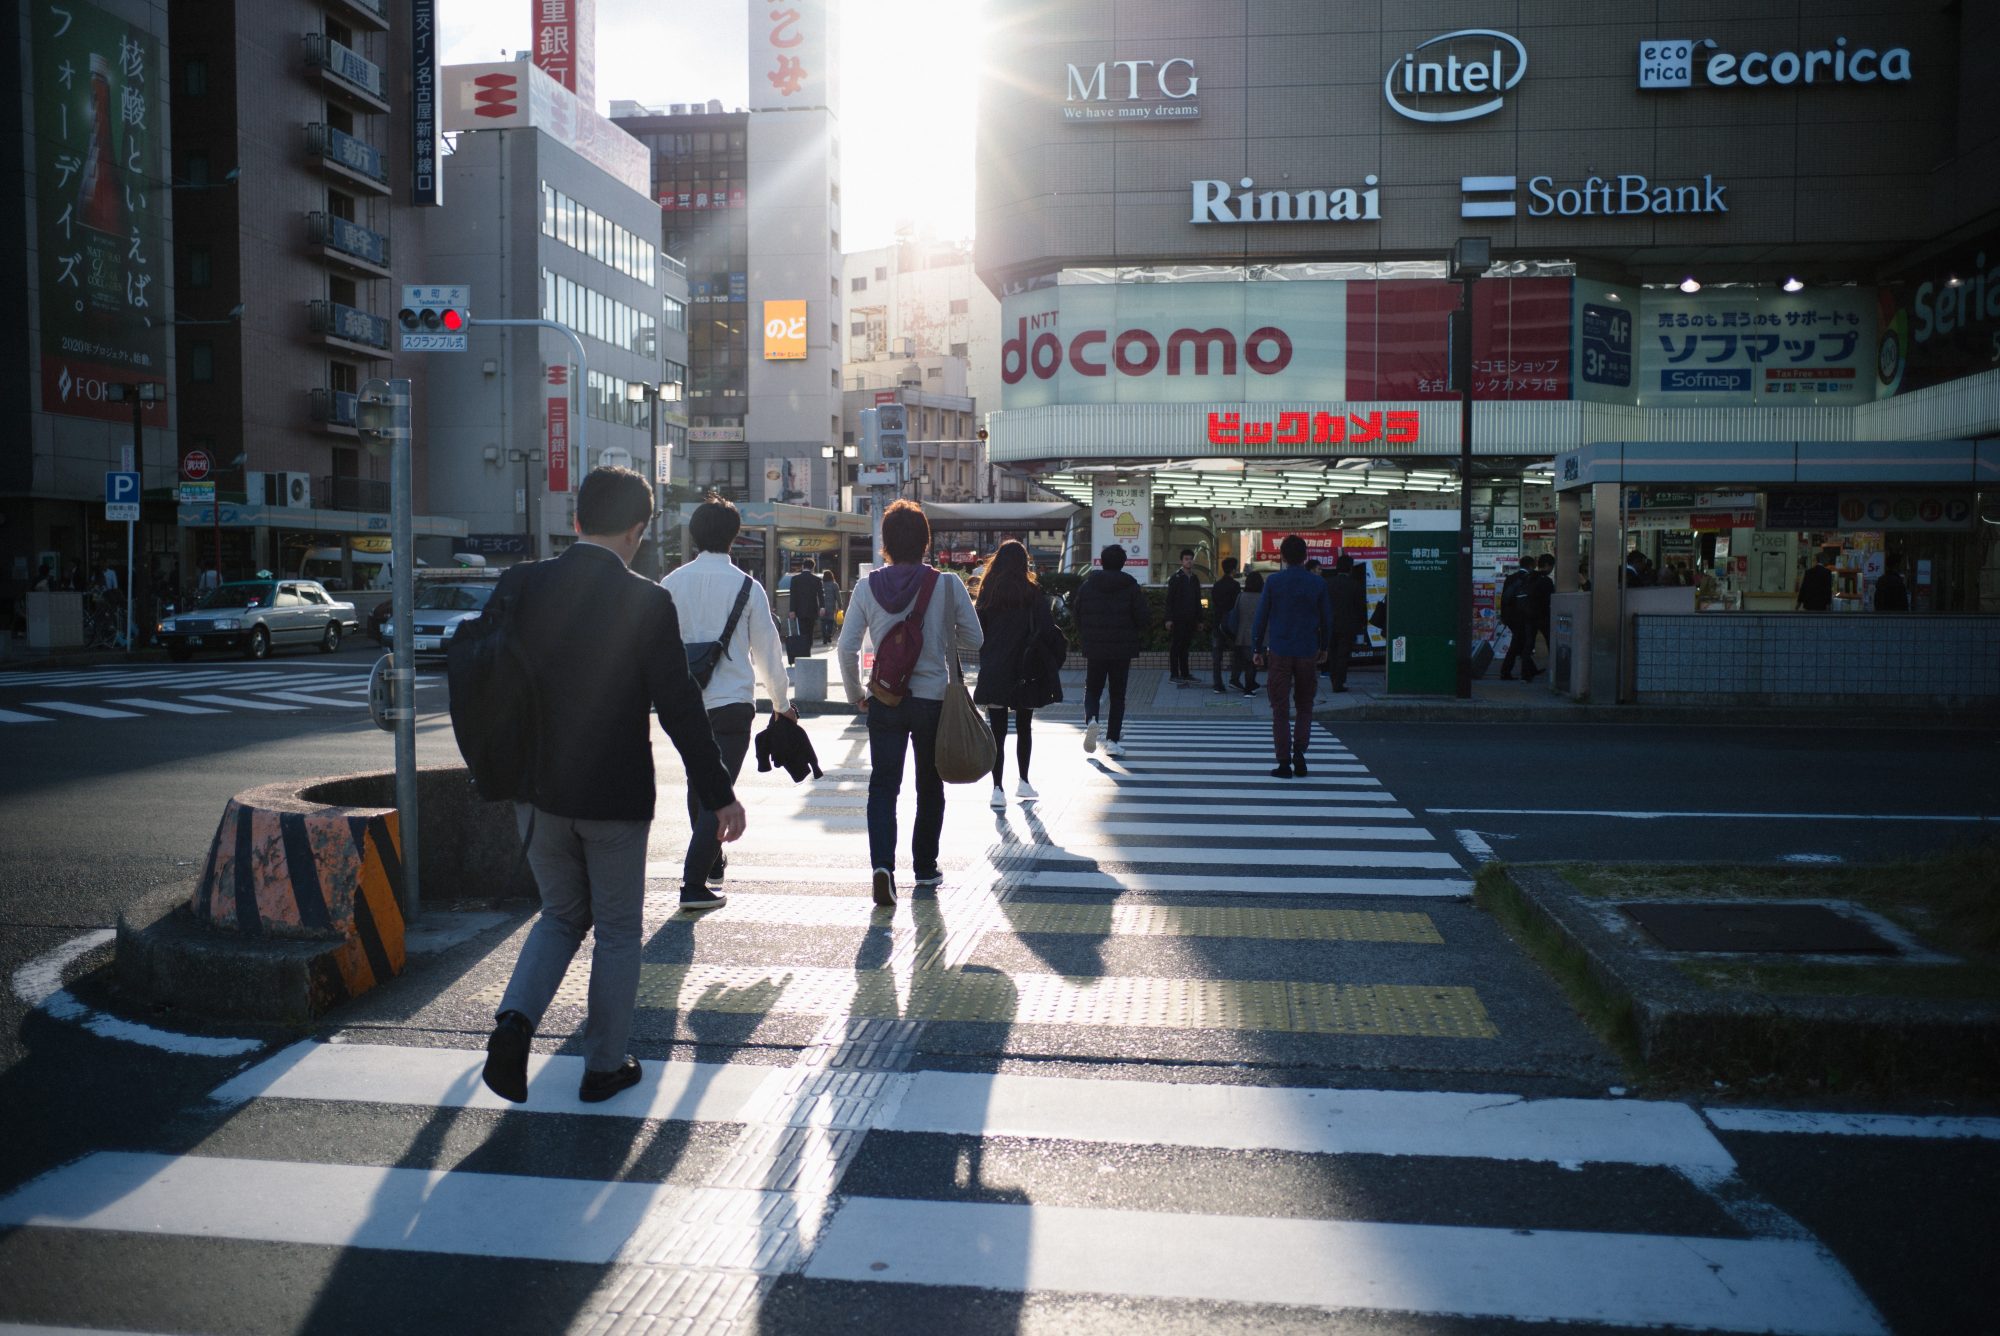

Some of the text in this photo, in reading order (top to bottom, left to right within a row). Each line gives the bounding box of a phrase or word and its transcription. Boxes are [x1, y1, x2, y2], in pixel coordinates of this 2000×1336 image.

[1645, 46, 1687, 60] eco
[1706, 35, 1912, 87] ecorica
[1064, 58, 1200, 101] MTG
[1405, 50, 1501, 93] intel
[1645, 63, 1687, 81] rica
[1064, 105, 1199, 119] We have many dreams
[1189, 175, 1381, 224] Rinnai
[1528, 174, 1728, 217] SoftBank
[1031, 310, 1060, 330] NTT
[1609, 316, 1629, 344] 4F
[1658, 310, 1860, 328] 売るのも 買うのも サポートも
[404, 336, 464, 348] スクランブル式
[1001, 316, 1292, 385] docomo
[1658, 330, 1859, 363] ソフマップ
[1586, 348, 1606, 376] 3F
[1671, 371, 1741, 390] Sofmap
[550, 405, 567, 470] 三重銀行
[1207, 411, 1419, 444] ビックカメラ
[114, 475, 134, 501] P
[1097, 488, 1146, 498] ネット取り置き
[1107, 499, 1136, 507] サービス
[1752, 533, 1787, 547] Pixel
[1412, 547, 1440, 558] 椿町線
[1867, 562, 1880, 573] 5F
